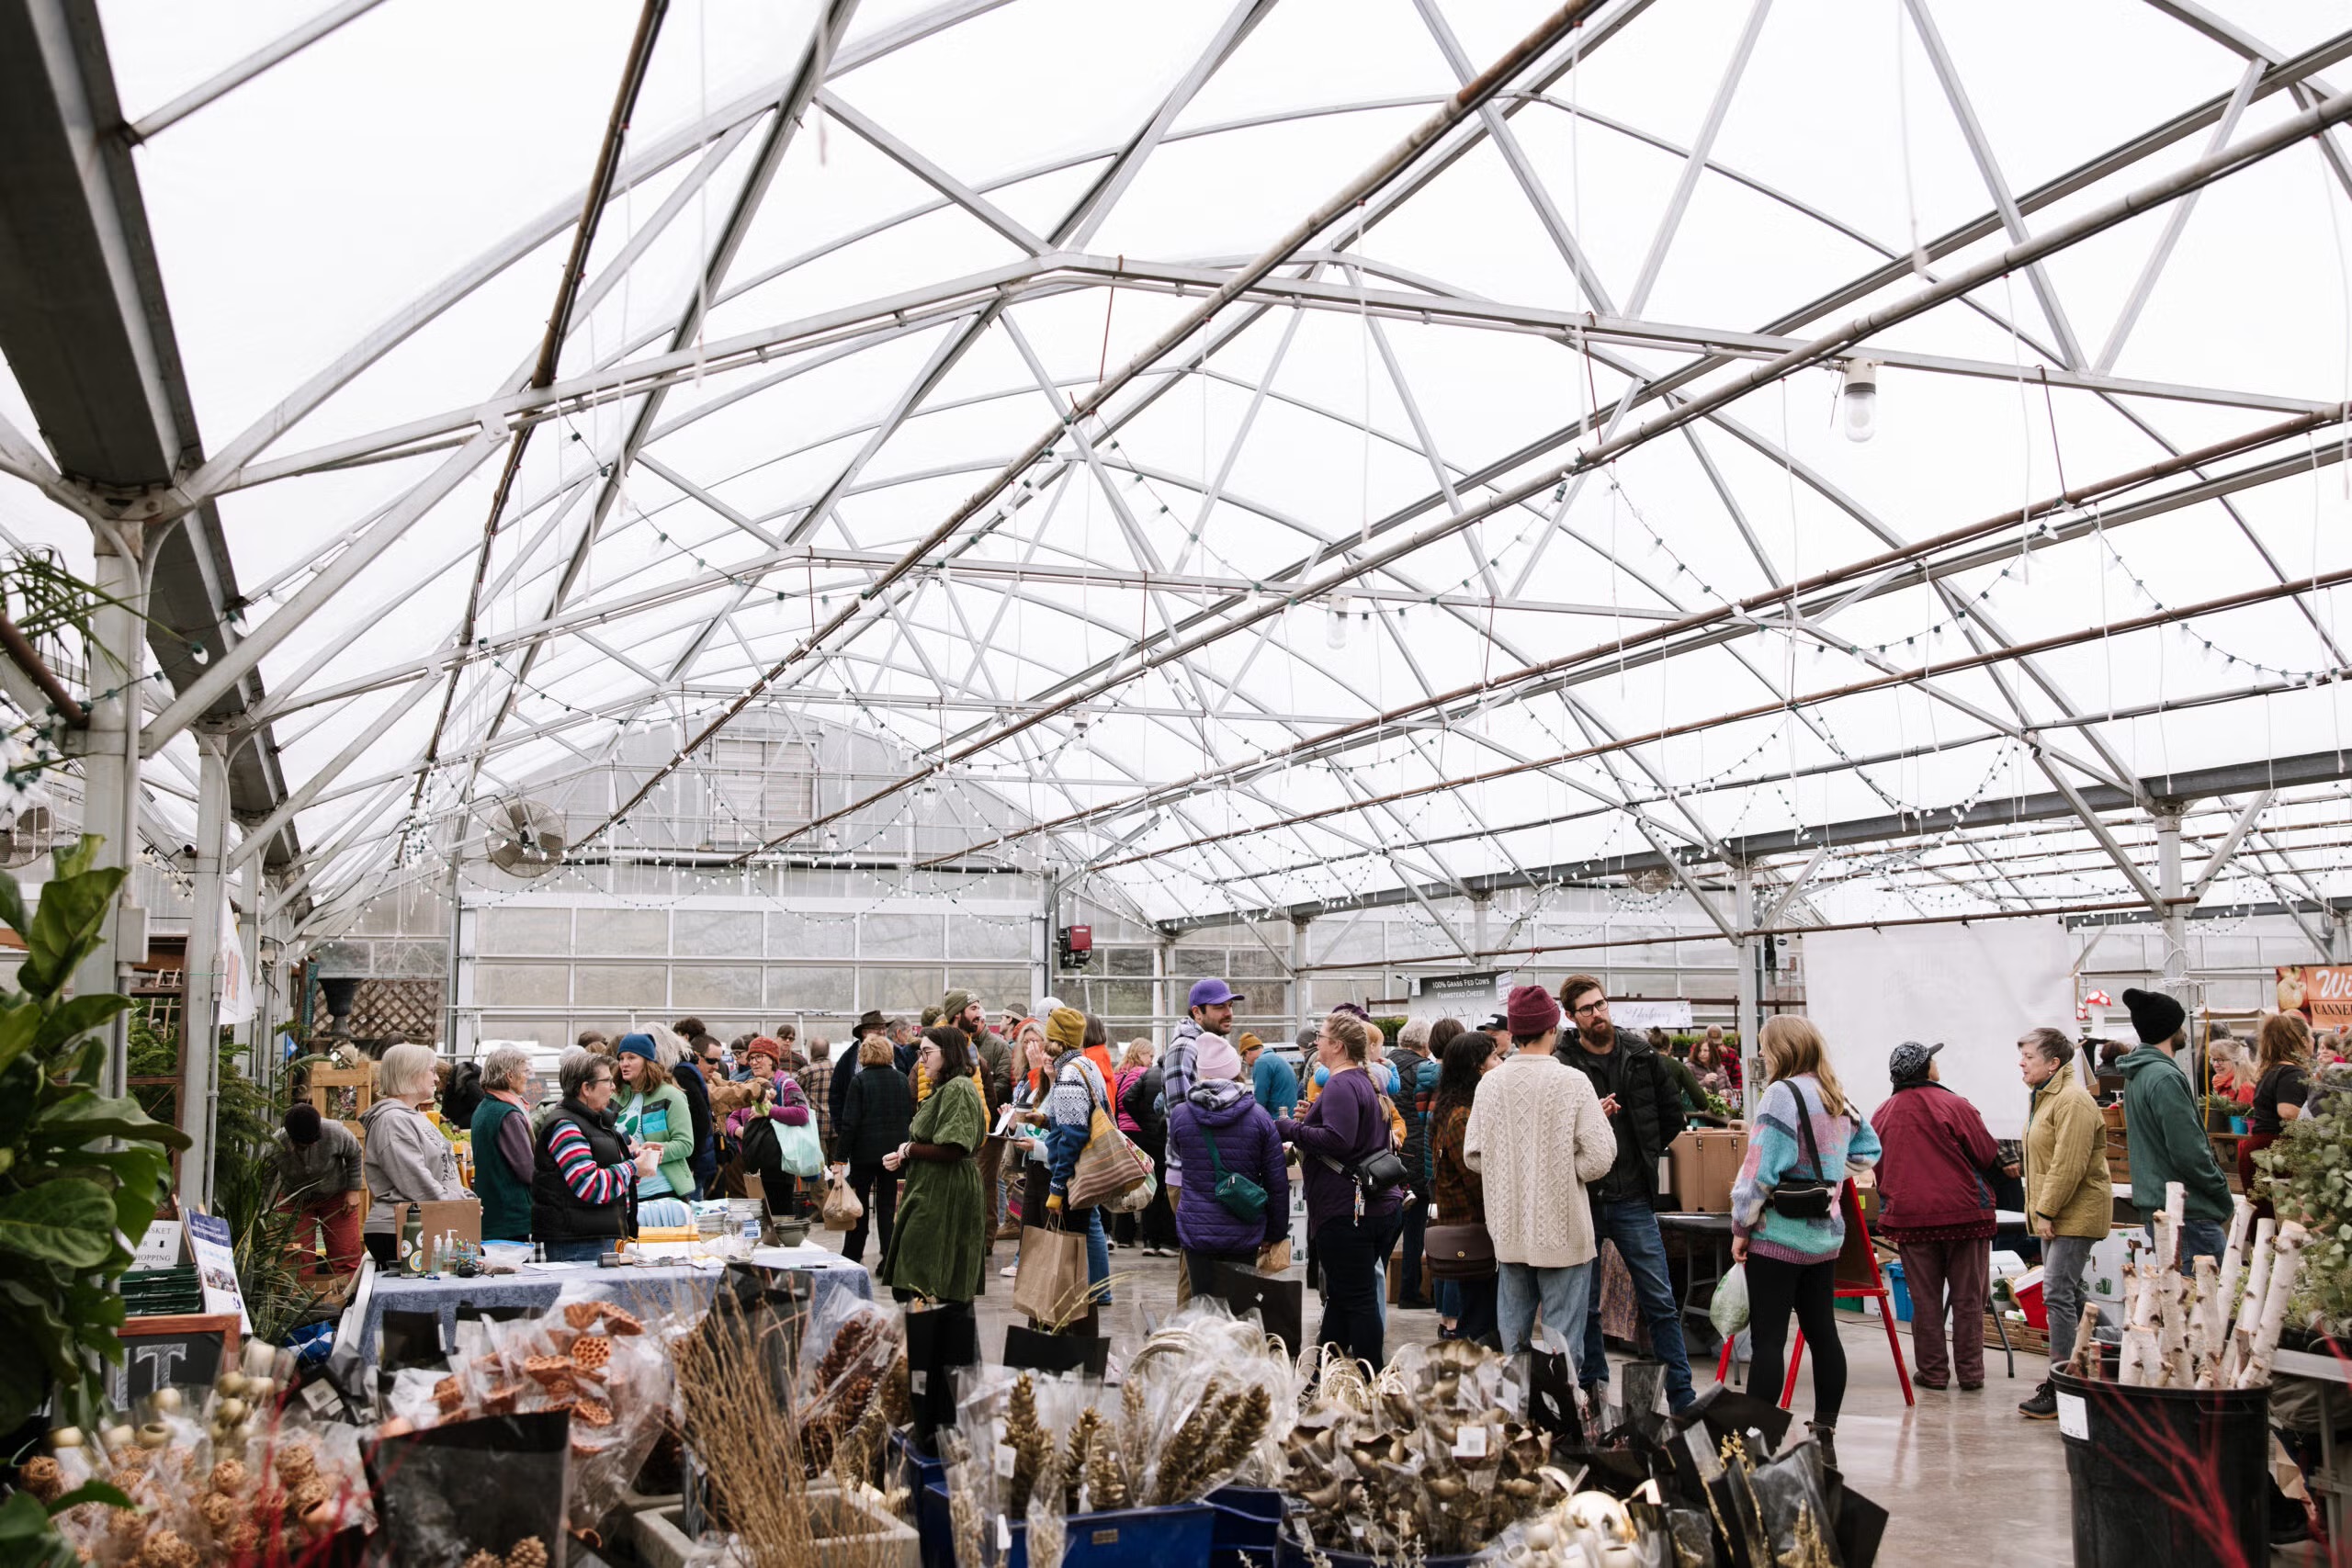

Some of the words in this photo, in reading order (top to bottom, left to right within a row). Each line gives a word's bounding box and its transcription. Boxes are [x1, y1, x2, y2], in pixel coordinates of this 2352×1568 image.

[1432, 981, 1446, 989] 100%
[2313, 1004, 2352, 1016] CANNE
[148, 1226, 172, 1235] SKET
[135, 1254, 171, 1262] HOPPING
